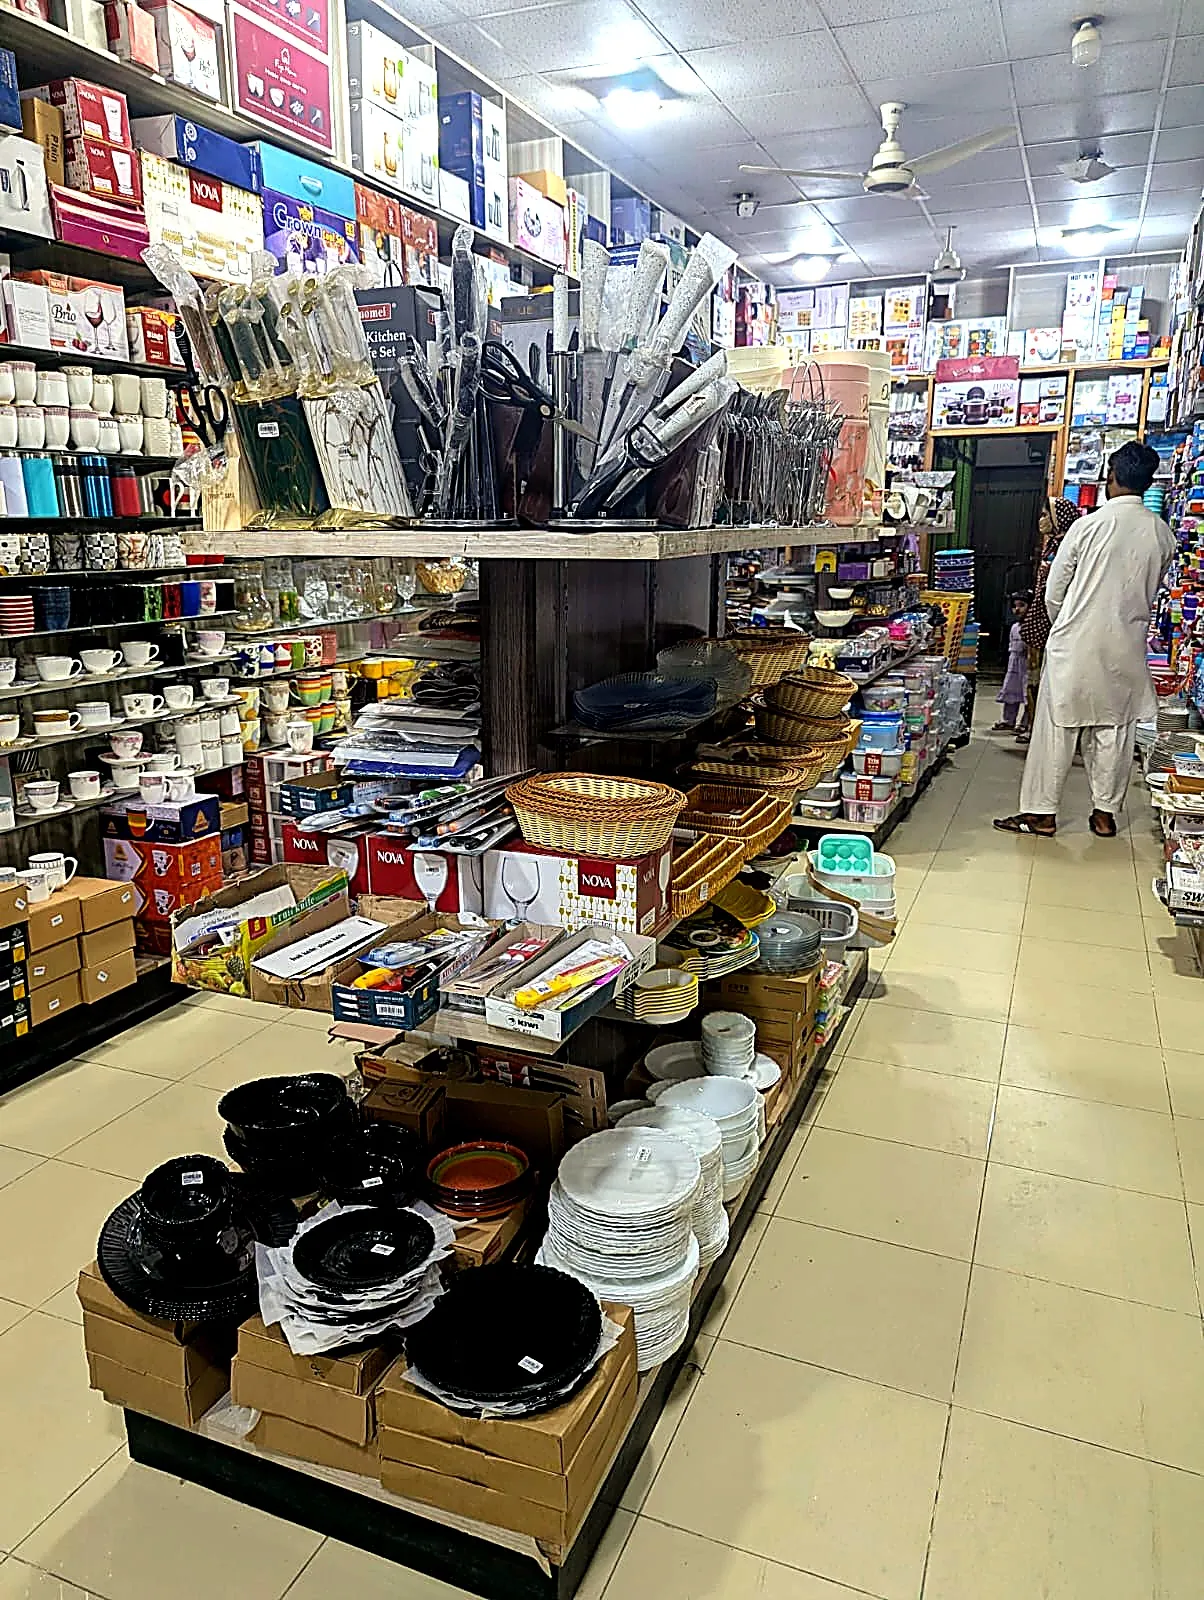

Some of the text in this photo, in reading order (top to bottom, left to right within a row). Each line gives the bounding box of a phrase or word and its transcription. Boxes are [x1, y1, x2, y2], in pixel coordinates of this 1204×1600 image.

[192, 180, 220, 203] NOVA
[273, 202, 321, 239] Crown
[51, 303, 77, 322] Brio
[366, 329, 407, 343] Kitchen
[380, 345, 396, 358] Set
[292, 837, 319, 851] NOVA
[377, 850, 405, 865] NOVA
[581, 873, 613, 889] NOVA
[517, 1019, 539, 1030] KIWI
